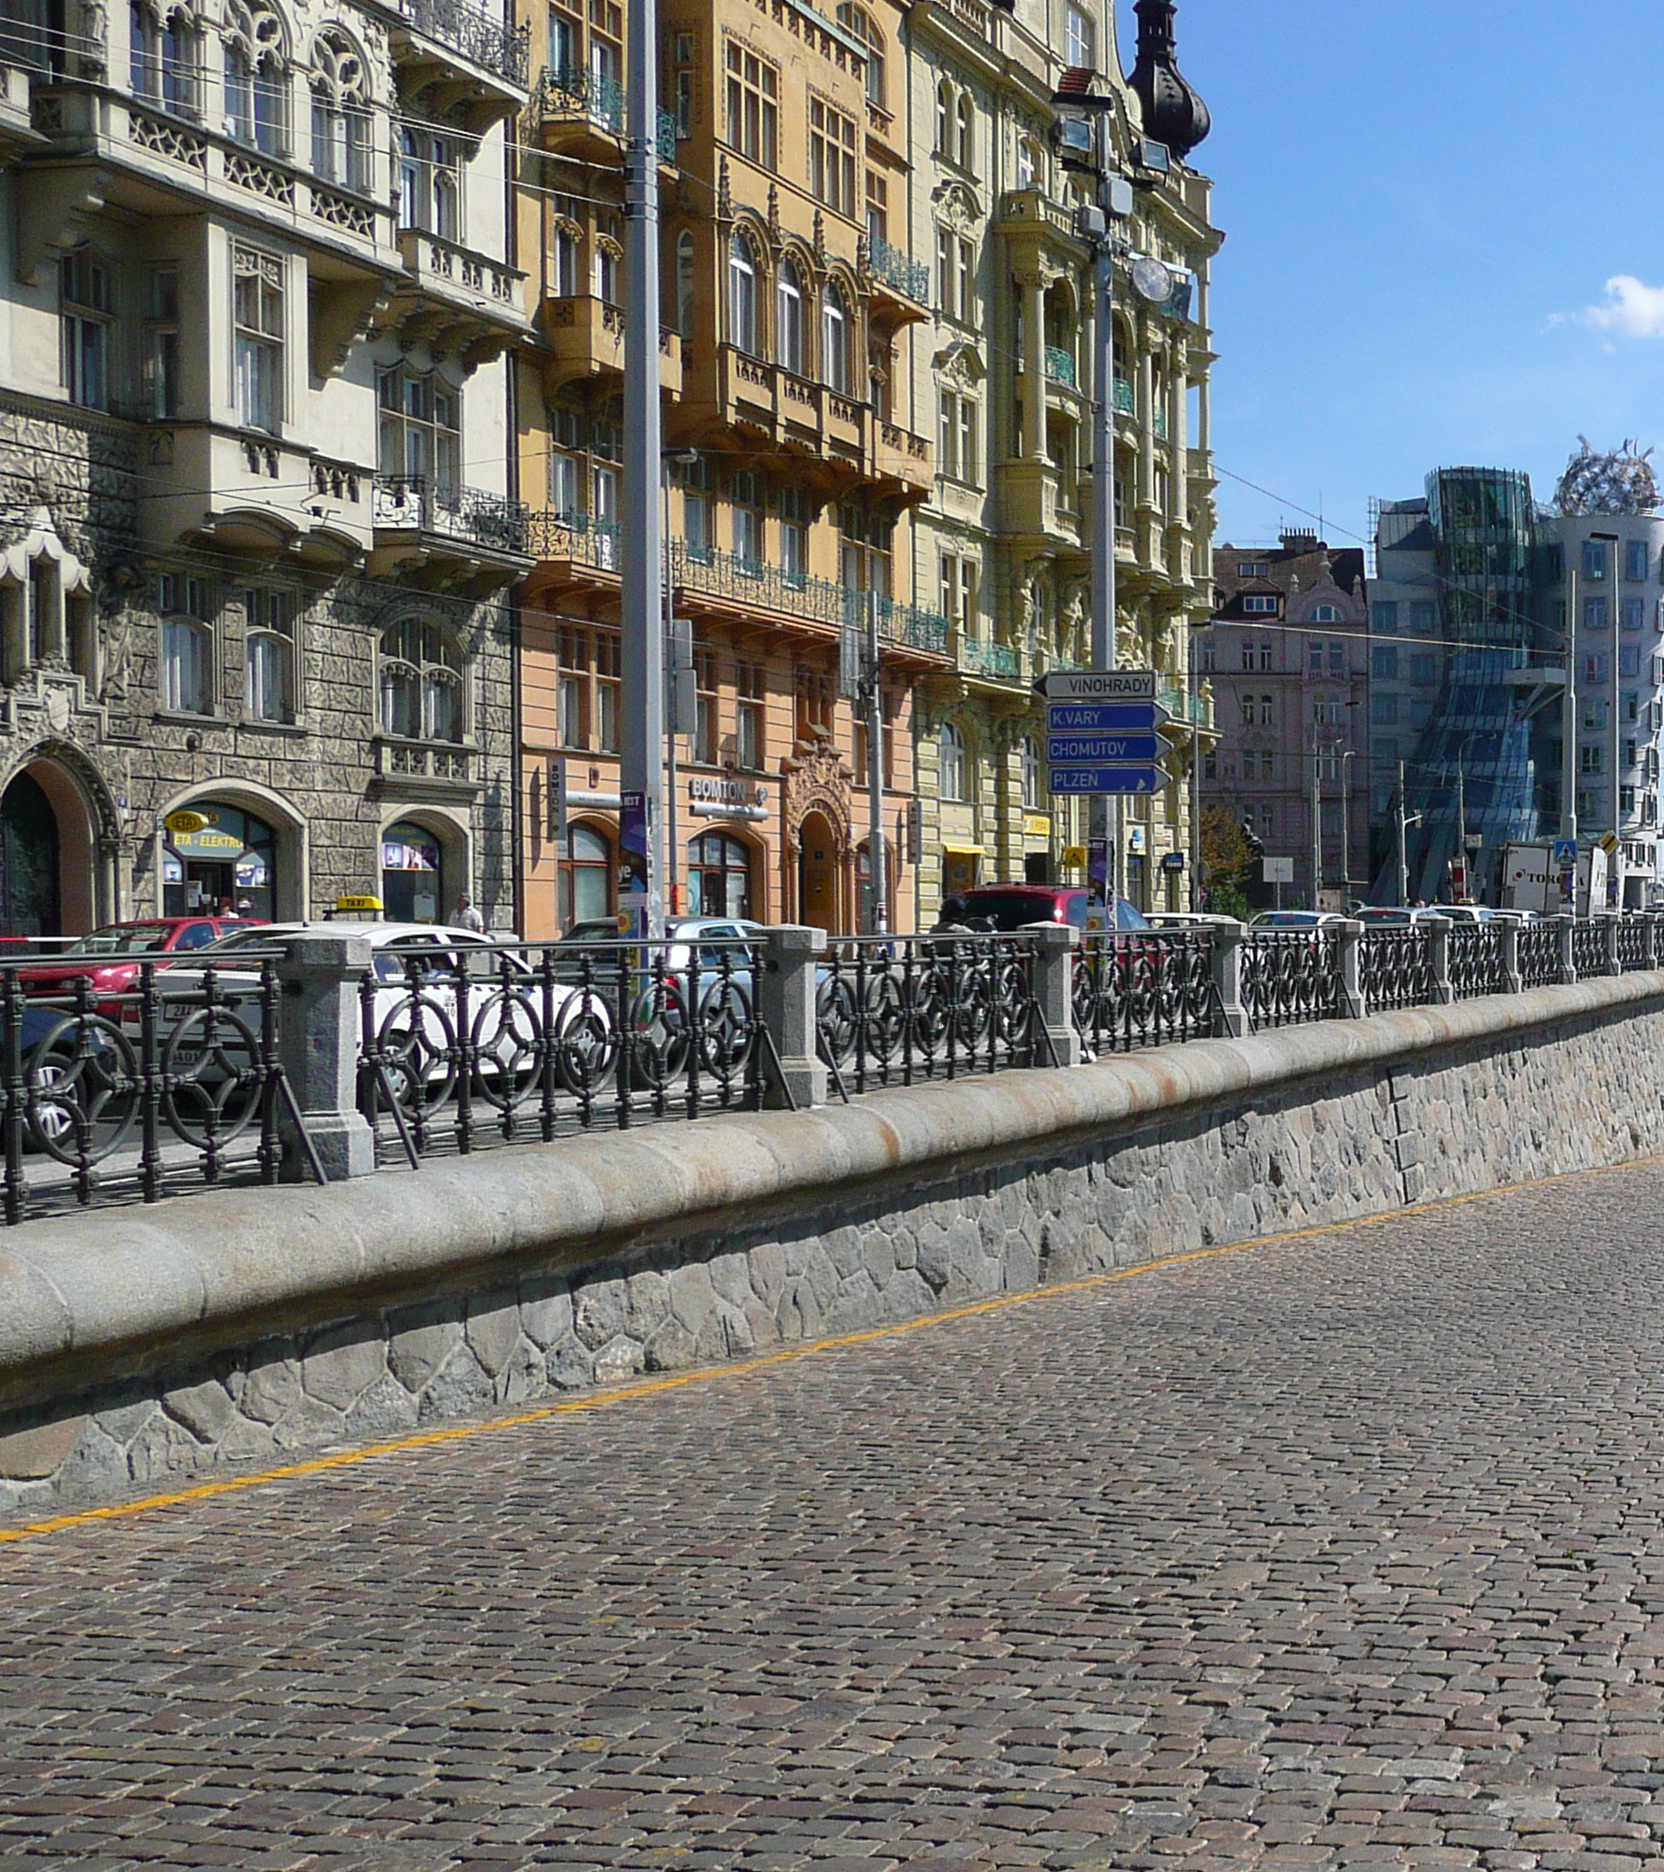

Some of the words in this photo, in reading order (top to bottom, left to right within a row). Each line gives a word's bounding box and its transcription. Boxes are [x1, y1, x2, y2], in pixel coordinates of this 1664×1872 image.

[1069, 678, 1150, 693] VINOHRADY
[1052, 711, 1101, 725] K.VARY
[1050, 741, 1127, 756] CHOMUTOV
[1054, 770, 1098, 787] PLZEŇ
[551, 764, 559, 813] BOMTON
[692, 778, 746, 801] BOMTON
[174, 834, 192, 846] ETA
